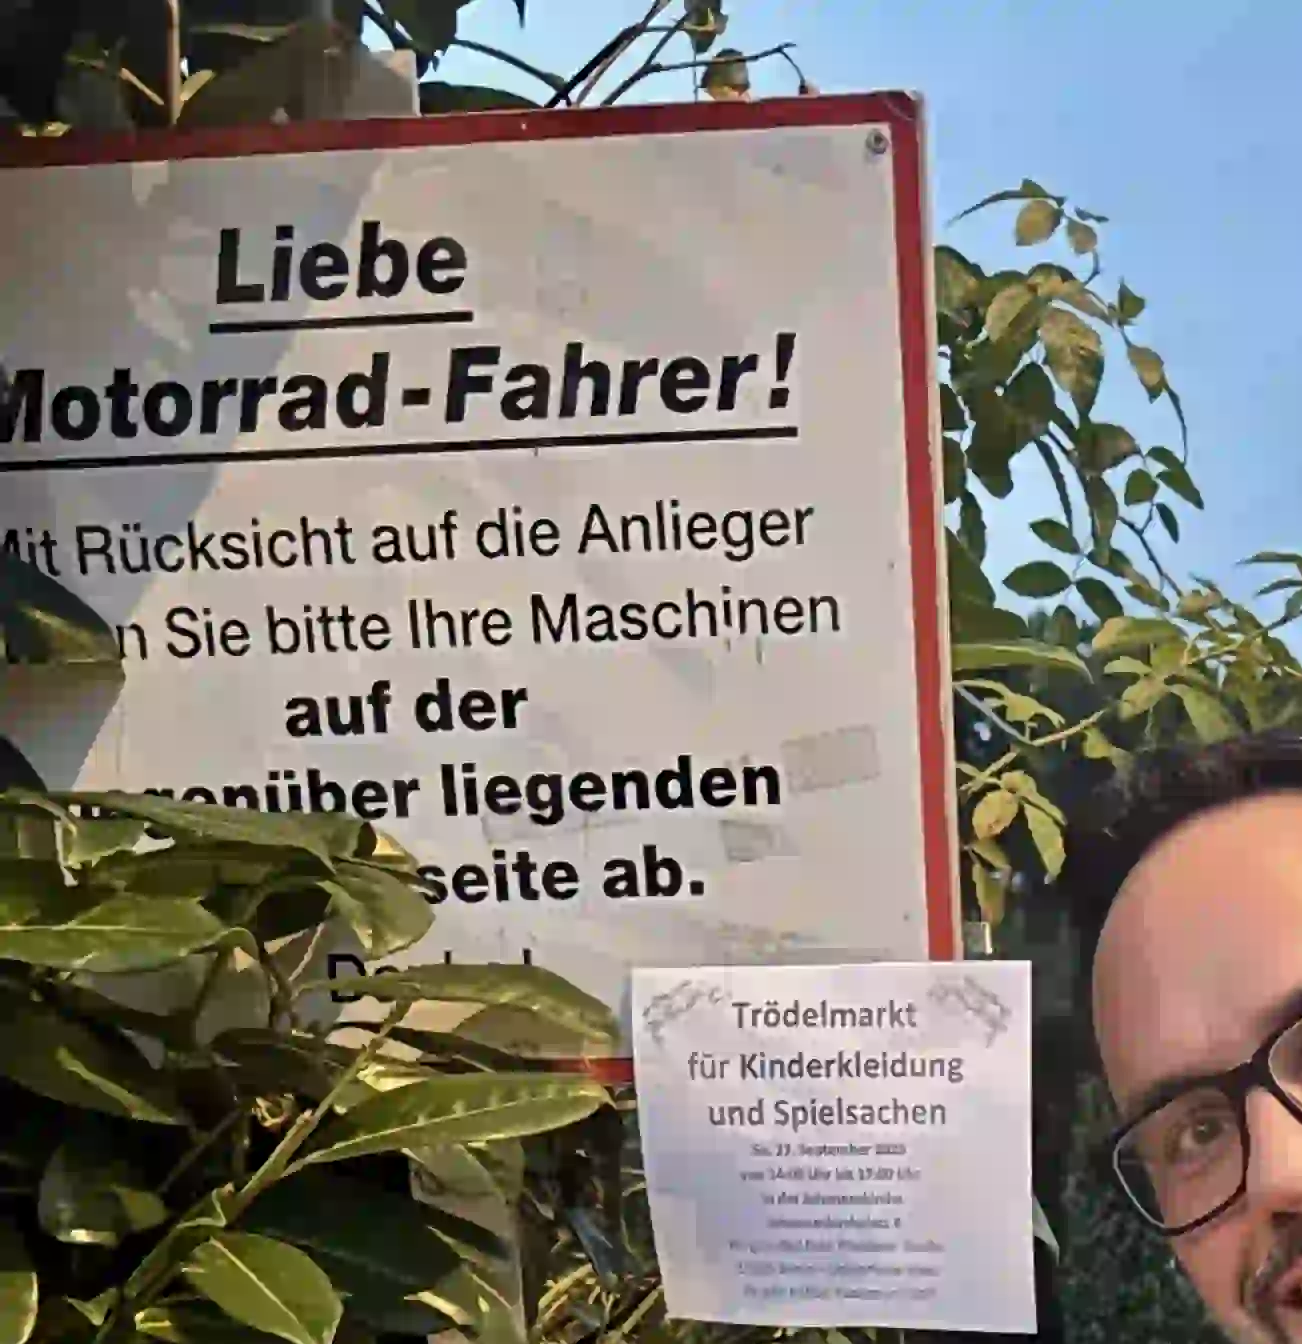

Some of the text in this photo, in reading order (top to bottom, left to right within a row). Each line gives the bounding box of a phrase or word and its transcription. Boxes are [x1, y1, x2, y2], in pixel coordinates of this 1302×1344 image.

[216, 219, 468, 305] Liebe
[76, 514, 356, 577] Rücksicht
[372, 511, 458, 565] auf
[477, 505, 562, 558] die
[578, 498, 815, 562] Anlieger
[165, 604, 251, 660] Sie
[266, 599, 392, 654] bitte
[408, 597, 513, 650] Ihre
[531, 588, 840, 645] Maschinen
[285, 677, 530, 737] auf der
[440, 754, 783, 828] liegenden
[603, 844, 706, 899] ab.
[731, 1000, 918, 1029] Trödelmarkt
[687, 1051, 965, 1083] für Kinderkleidung
[708, 1097, 946, 1132] und Spielsachen
